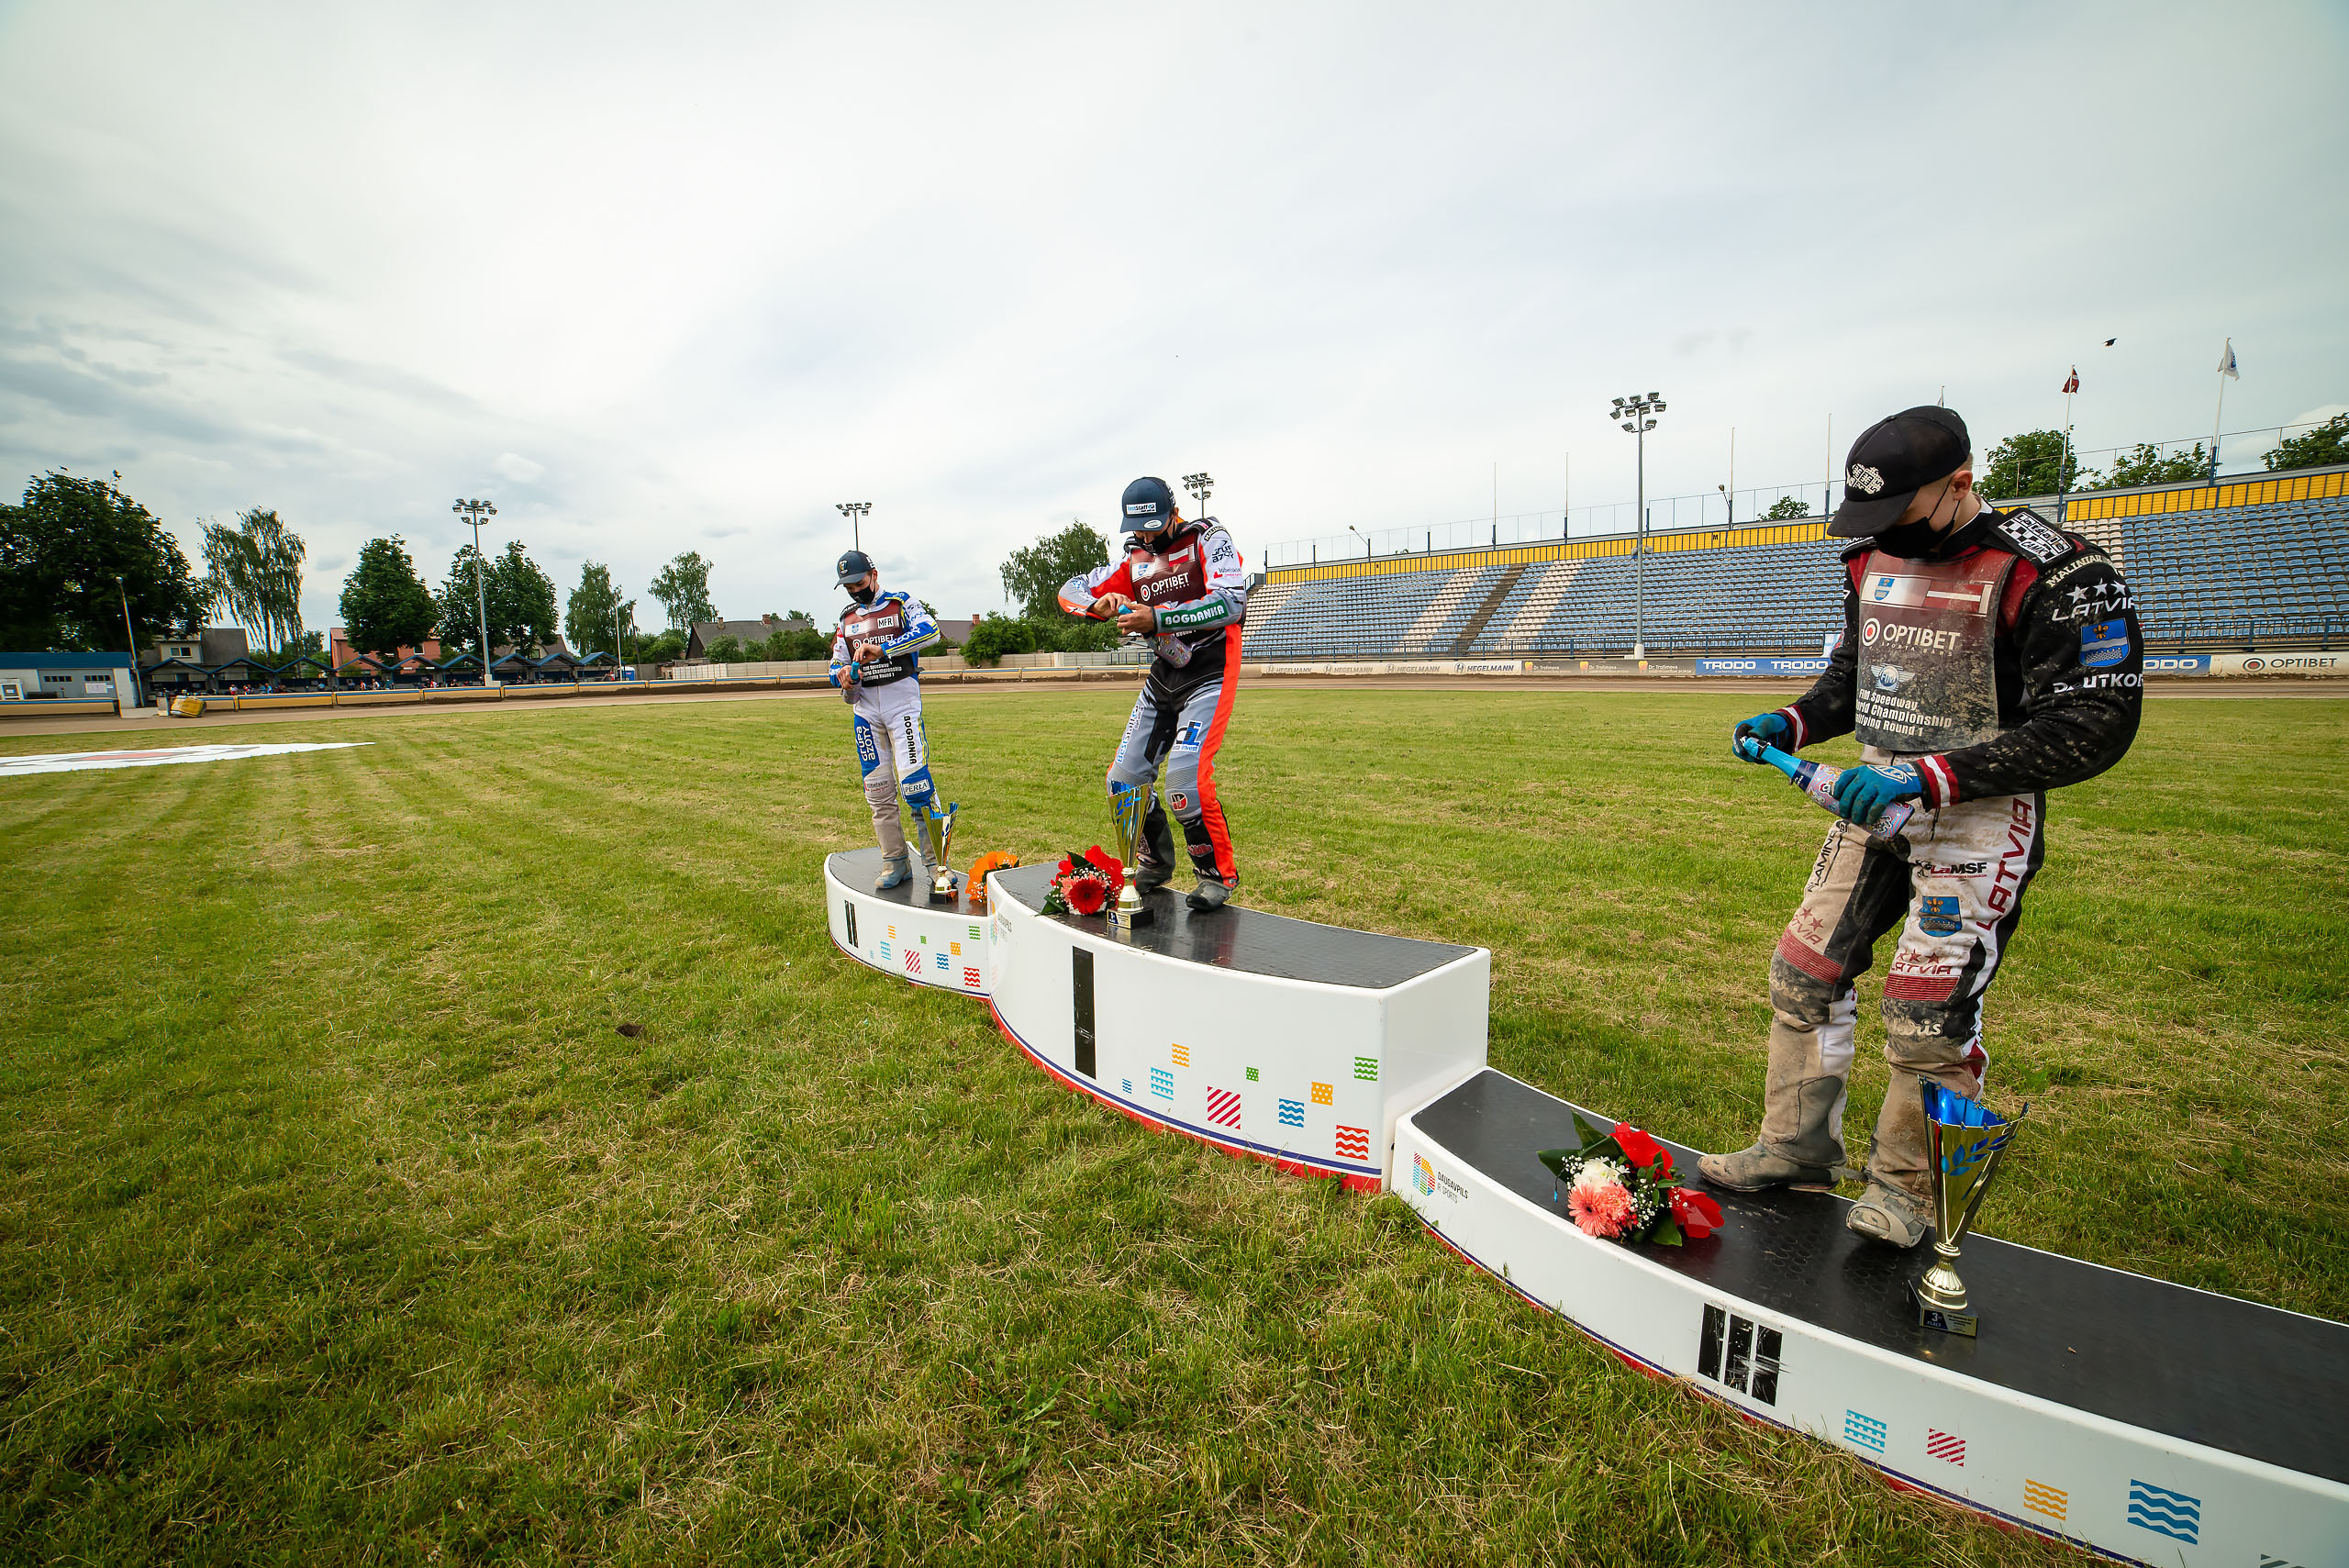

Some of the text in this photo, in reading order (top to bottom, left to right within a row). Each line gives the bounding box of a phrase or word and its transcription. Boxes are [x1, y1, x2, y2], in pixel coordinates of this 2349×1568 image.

[1151, 572, 1189, 593] OPTIBET
[1164, 605, 1225, 625] BOGDANKA
[863, 634, 895, 645] OPTIBET
[1883, 623, 1961, 651] OPTIBET
[1702, 661, 1756, 670] TRODO
[1771, 661, 1829, 670] TRODO
[2270, 658, 2337, 668] OPTIBET
[1859, 689, 1918, 710] FIM Speedway
[1871, 703, 1953, 728] Championship
[1883, 720, 1915, 735] Round
[1918, 727, 1923, 737] 1
[904, 716, 918, 764] BOGDANKA
[1930, 862, 1987, 874] LaMSF
[1976, 796, 2032, 931] LATVIA
[1891, 964, 1953, 975] LATVIA
